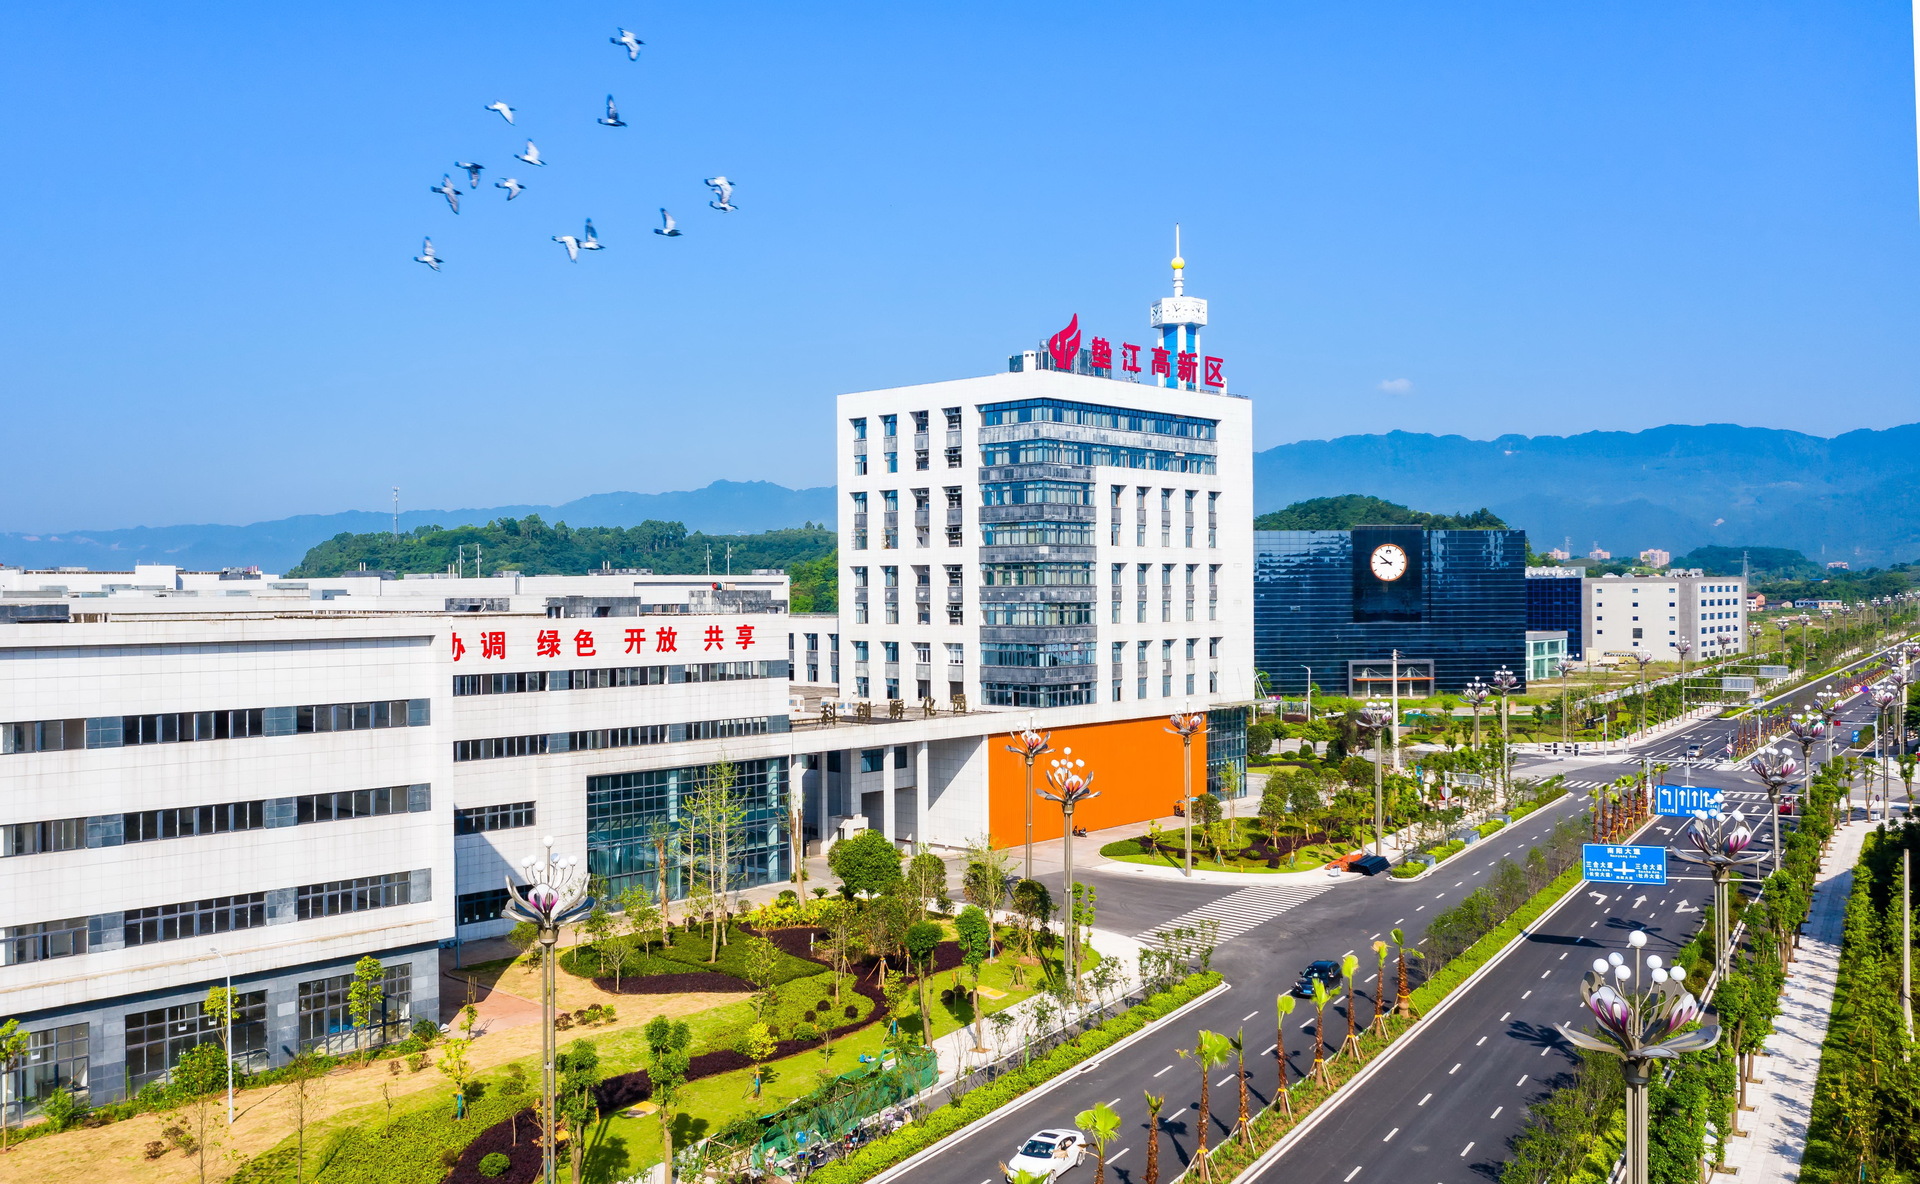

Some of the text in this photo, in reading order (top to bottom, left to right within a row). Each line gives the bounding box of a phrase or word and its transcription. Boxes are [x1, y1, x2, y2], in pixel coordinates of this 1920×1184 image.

[1091, 336, 1225, 388] 垫江高新区
[536, 629, 597, 658] 绿色
[624, 626, 678, 654] 开放
[703, 624, 756, 651] 共享
[821, 693, 967, 726] 科创孵化园
